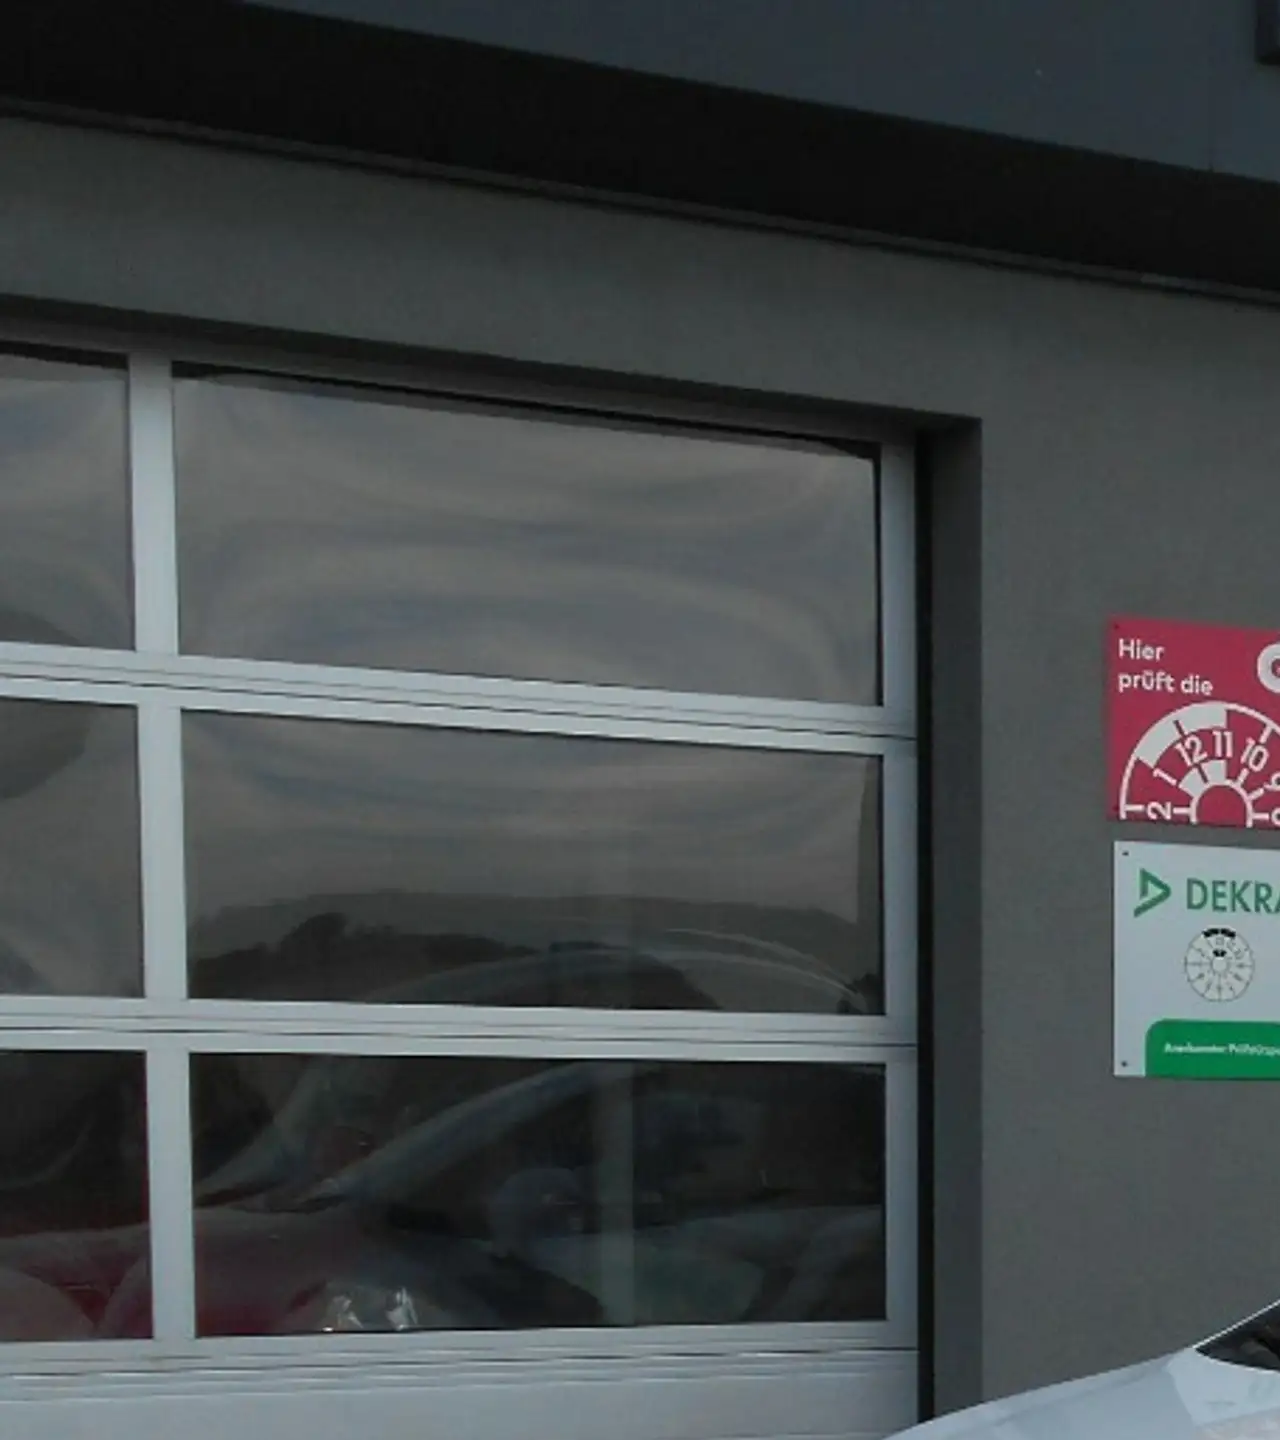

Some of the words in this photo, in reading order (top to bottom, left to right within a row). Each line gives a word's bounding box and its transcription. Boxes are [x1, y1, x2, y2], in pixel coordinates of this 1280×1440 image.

[1118, 638, 1164, 661] Hier
[1118, 670, 1175, 693] prüft
[1181, 676, 1213, 695] die
[1174, 735, 1208, 767] 12
[1212, 731, 1234, 758] 11
[1240, 736, 1269, 772] 10
[1147, 802, 1172, 820] 2
